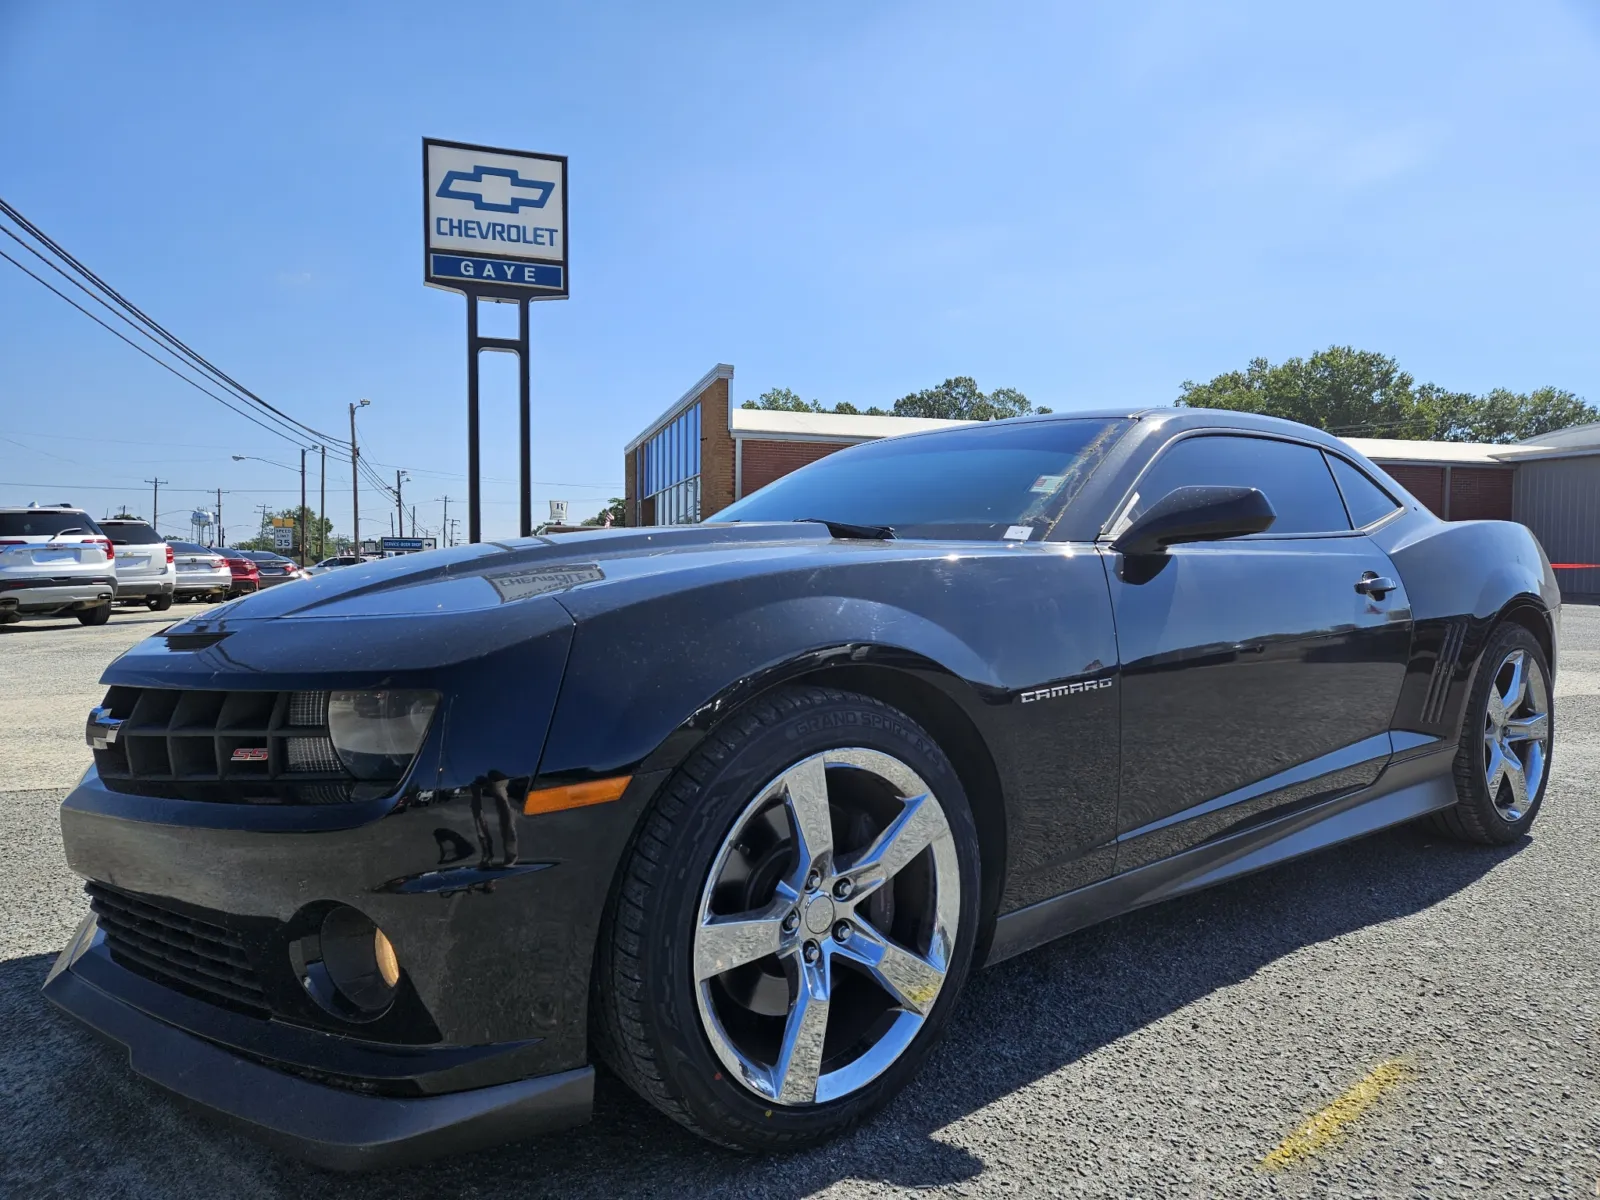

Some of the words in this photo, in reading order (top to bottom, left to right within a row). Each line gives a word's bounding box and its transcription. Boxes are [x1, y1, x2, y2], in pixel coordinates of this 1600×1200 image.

[436, 217, 558, 246] CHEVROLET
[460, 261, 536, 282] GAYE
[276, 539, 291, 547] 35
[1020, 678, 1112, 703] CAMARO
[795, 710, 858, 736] GRAND
[860, 711, 909, 739] SPORT
[230, 747, 269, 761] SS
